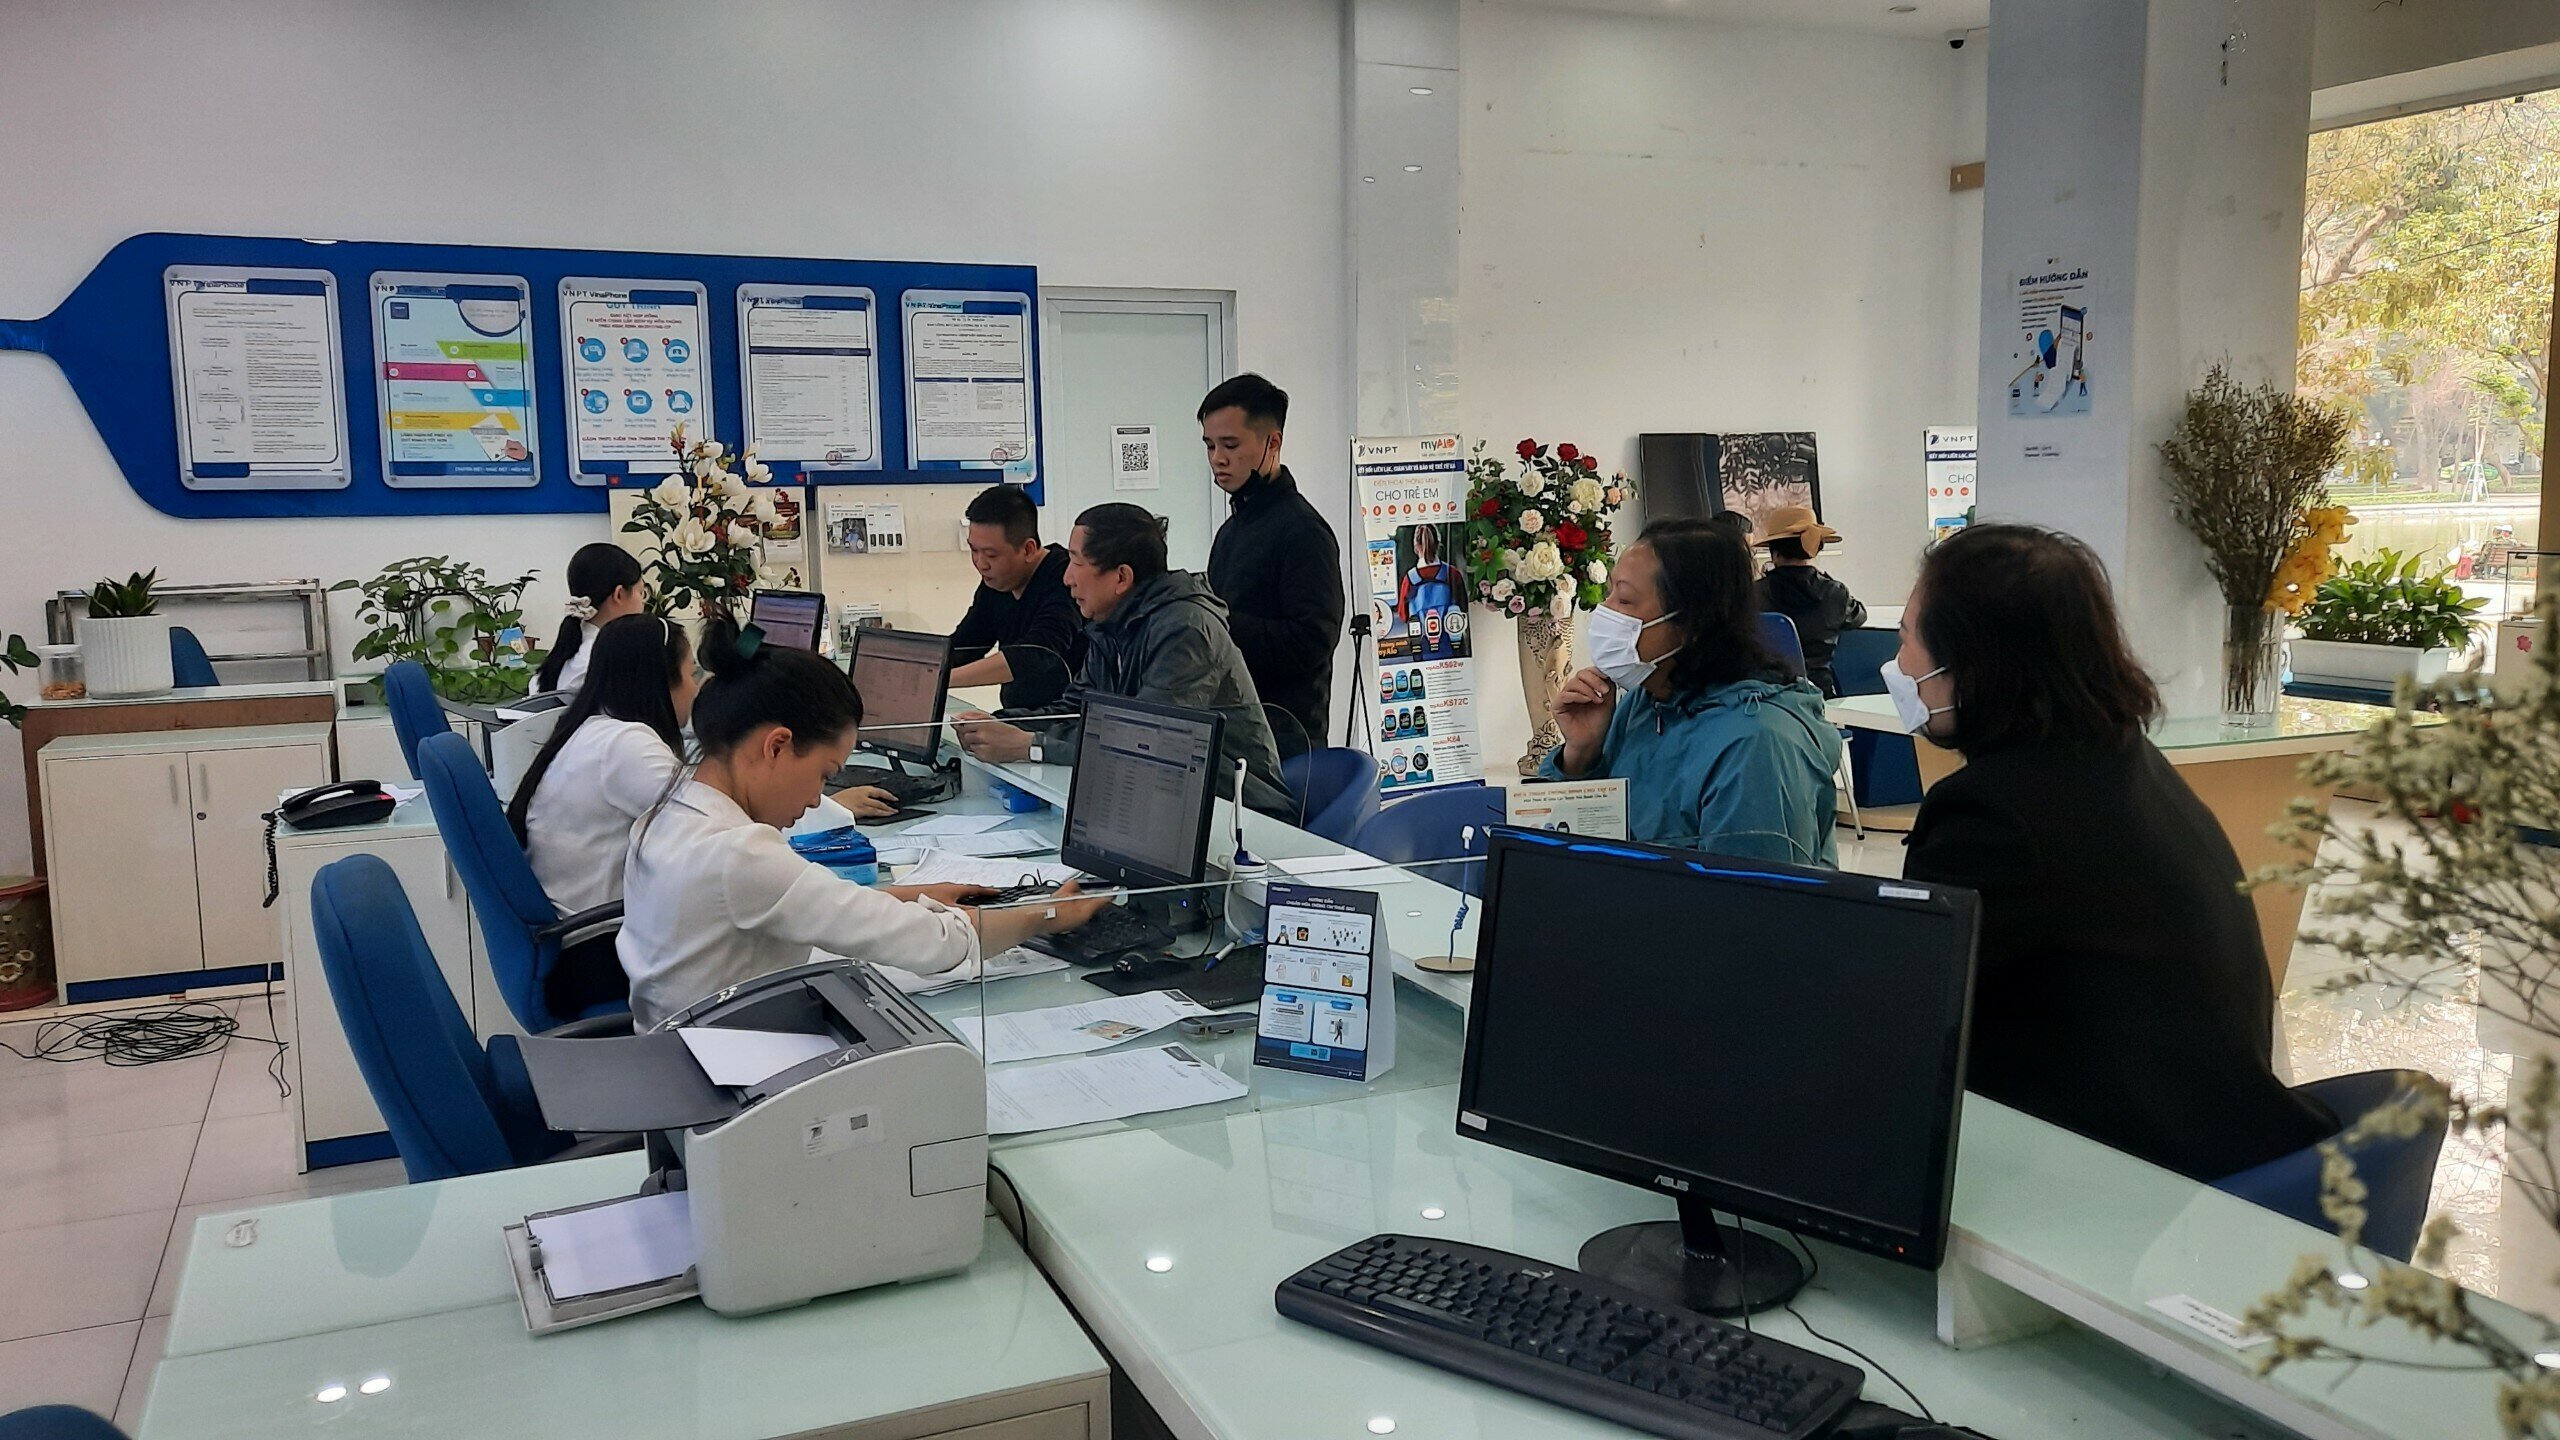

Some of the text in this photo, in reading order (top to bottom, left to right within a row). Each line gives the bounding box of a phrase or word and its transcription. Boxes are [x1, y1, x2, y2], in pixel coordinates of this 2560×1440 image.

[1368, 446, 1398, 454] VNPT
[1948, 473, 1975, 484] CHO
[1375, 486, 1439, 502] CHO TRẺ EM
[1653, 1174, 1690, 1192] ASUS
